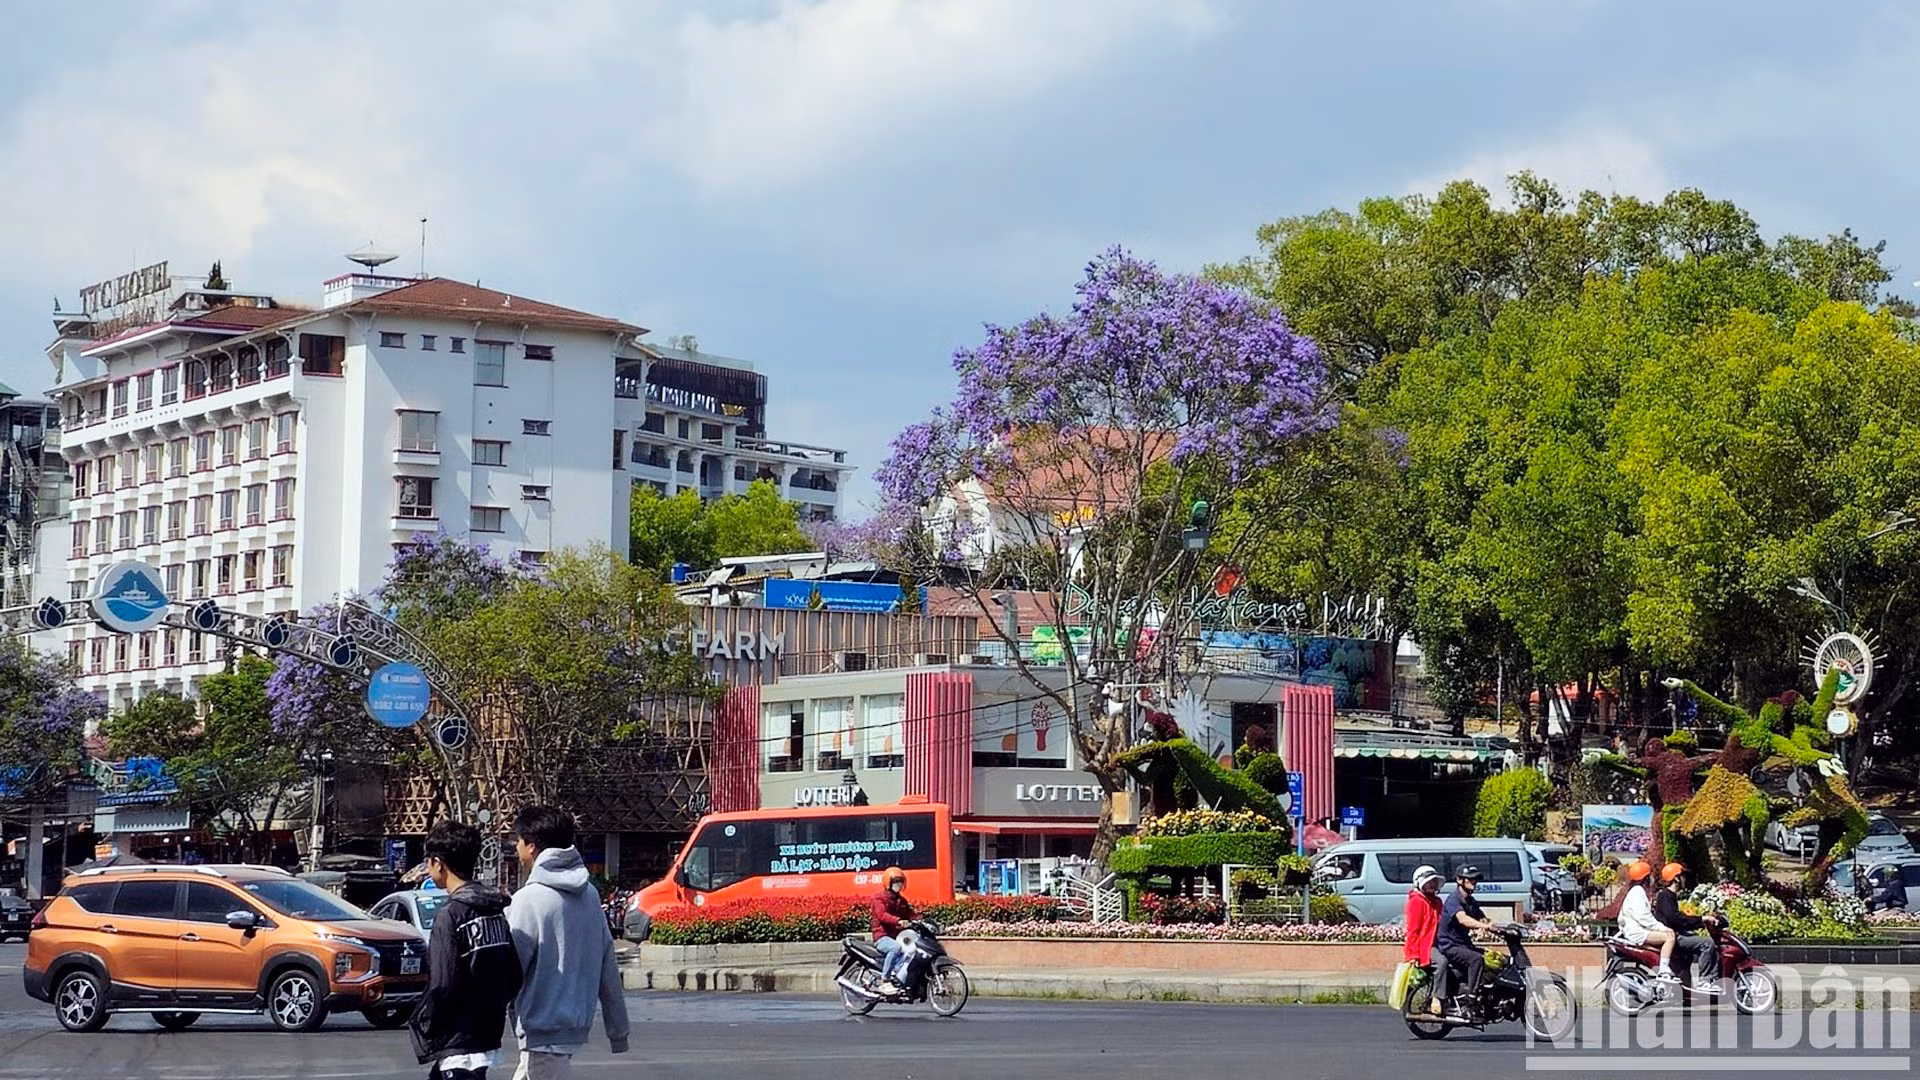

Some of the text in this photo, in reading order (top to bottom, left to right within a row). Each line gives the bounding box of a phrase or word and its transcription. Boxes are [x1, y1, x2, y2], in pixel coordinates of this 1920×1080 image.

[80, 260, 171, 315] TTC HOTEL
[1016, 784, 1106, 801] LOTTER
[779, 844, 796, 856] XE
[874, 840, 914, 851] TRANG
